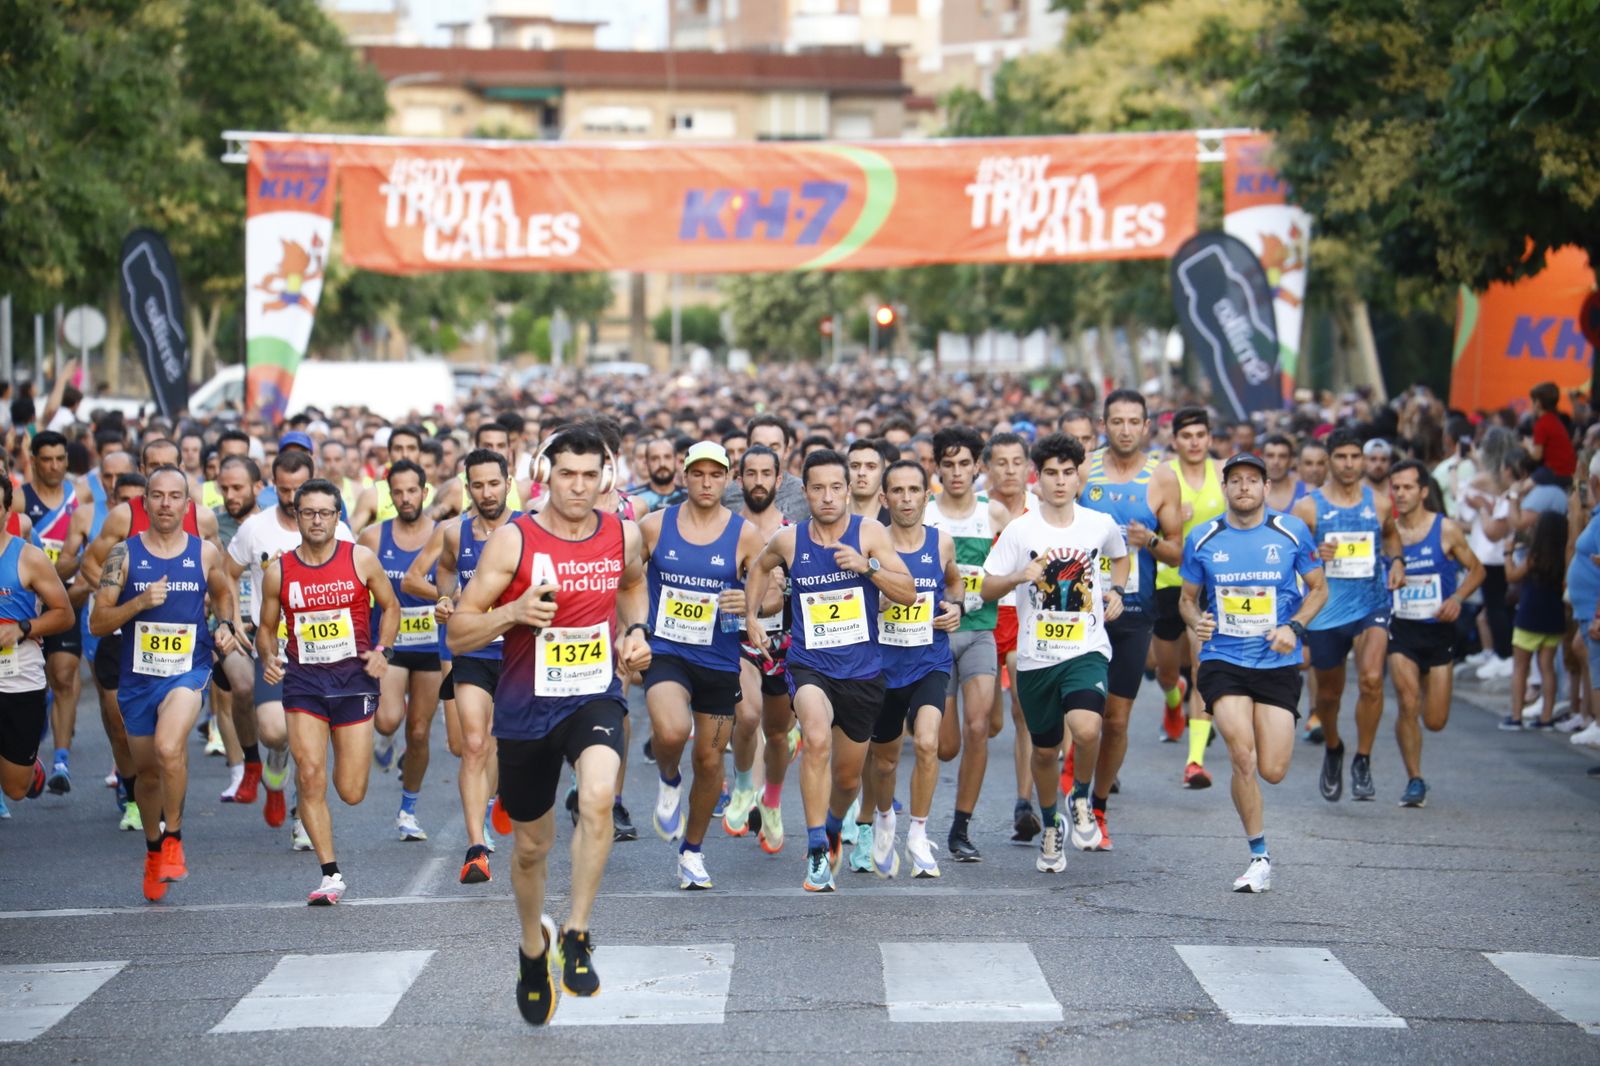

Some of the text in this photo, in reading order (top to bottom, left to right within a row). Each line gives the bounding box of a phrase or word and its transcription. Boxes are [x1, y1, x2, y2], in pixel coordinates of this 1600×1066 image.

[379, 179, 516, 229] TROTA
[965, 173, 1098, 230] TROTA
[422, 212, 581, 262] CALLES
[1007, 202, 1167, 258] CALLES
[1347, 544, 1355, 556] 9
[660, 571, 725, 589] TROTASIERRA
[796, 570, 860, 587] TROTASIERRA
[1214, 571, 1282, 583] TROTASIERRA
[673, 602, 704, 619] 260
[829, 604, 840, 619] 2
[891, 606, 922, 621] 317
[1241, 598, 1251, 612] 4
[308, 622, 340, 639] 103
[403, 617, 431, 632] 146
[1045, 623, 1075, 638] 997
[150, 635, 182, 651] 816
[552, 641, 602, 663] 1374
